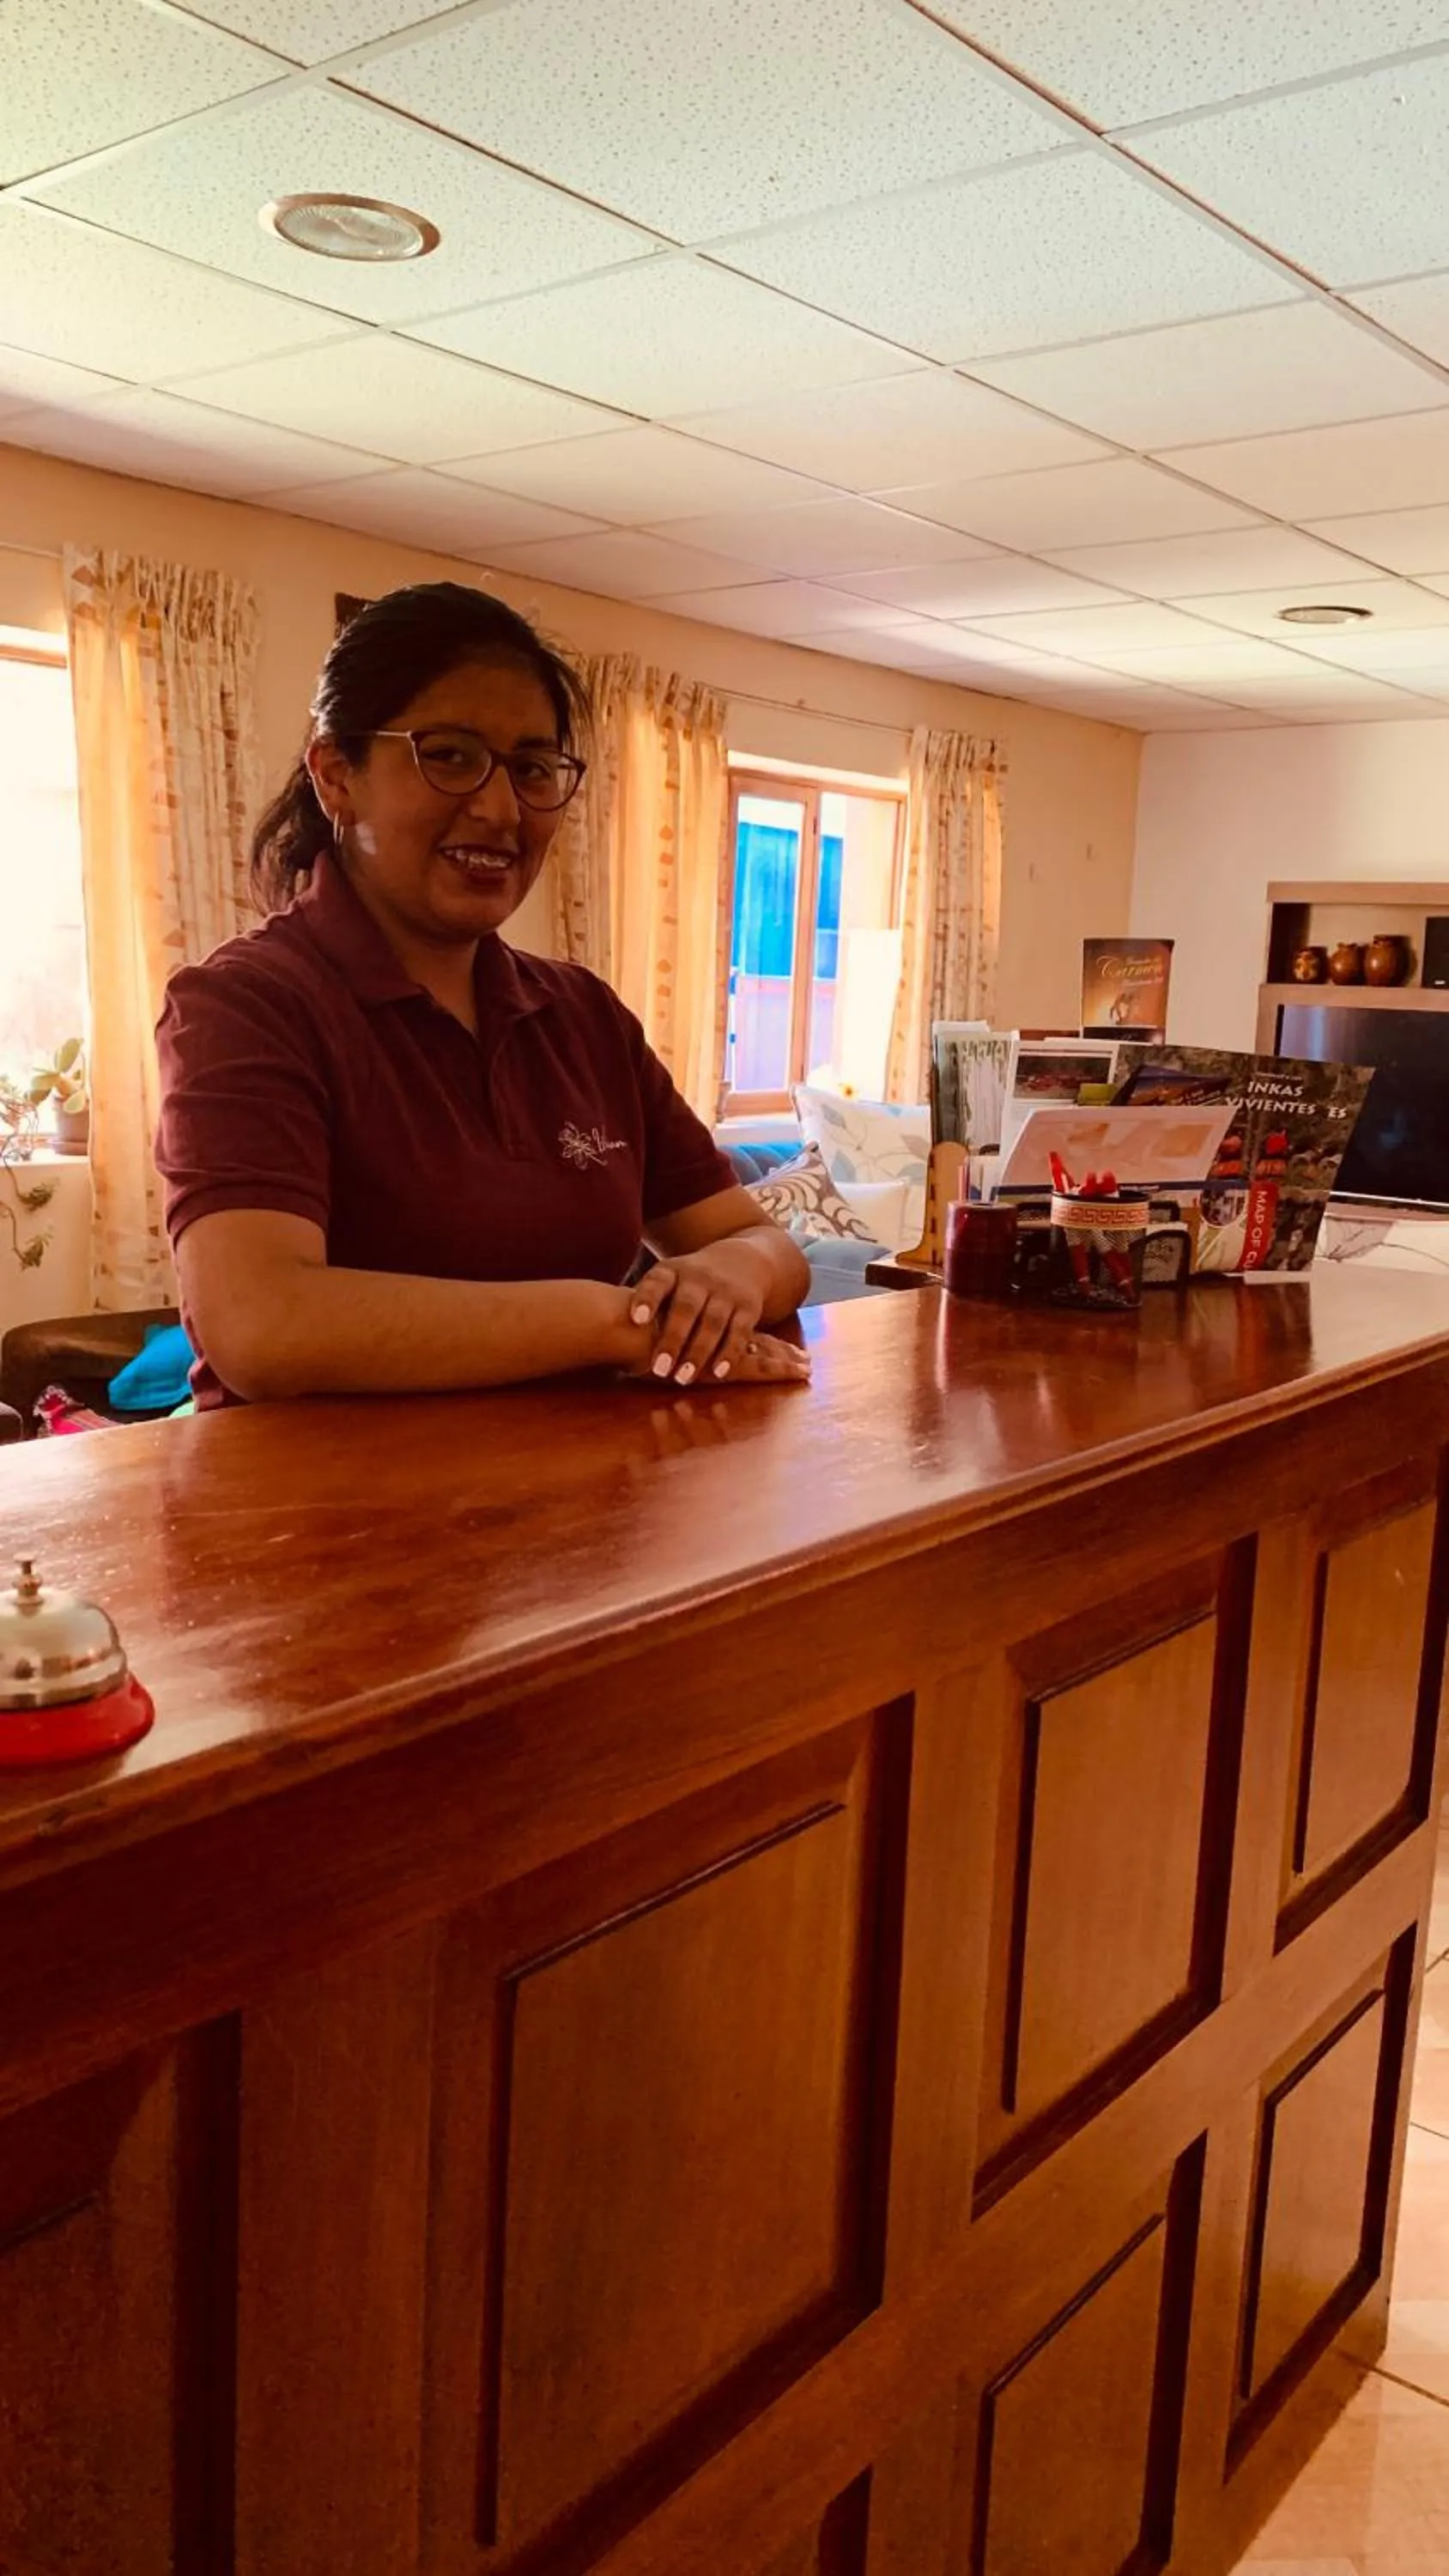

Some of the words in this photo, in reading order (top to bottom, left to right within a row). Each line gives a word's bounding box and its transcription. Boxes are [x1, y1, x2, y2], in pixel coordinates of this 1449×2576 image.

[1247, 1081, 1304, 1097] INKAS
[1225, 1097, 1316, 1115] VIVIENTES
[1255, 1190, 1268, 1224] MAP
[1251, 1227, 1263, 1248] OF
